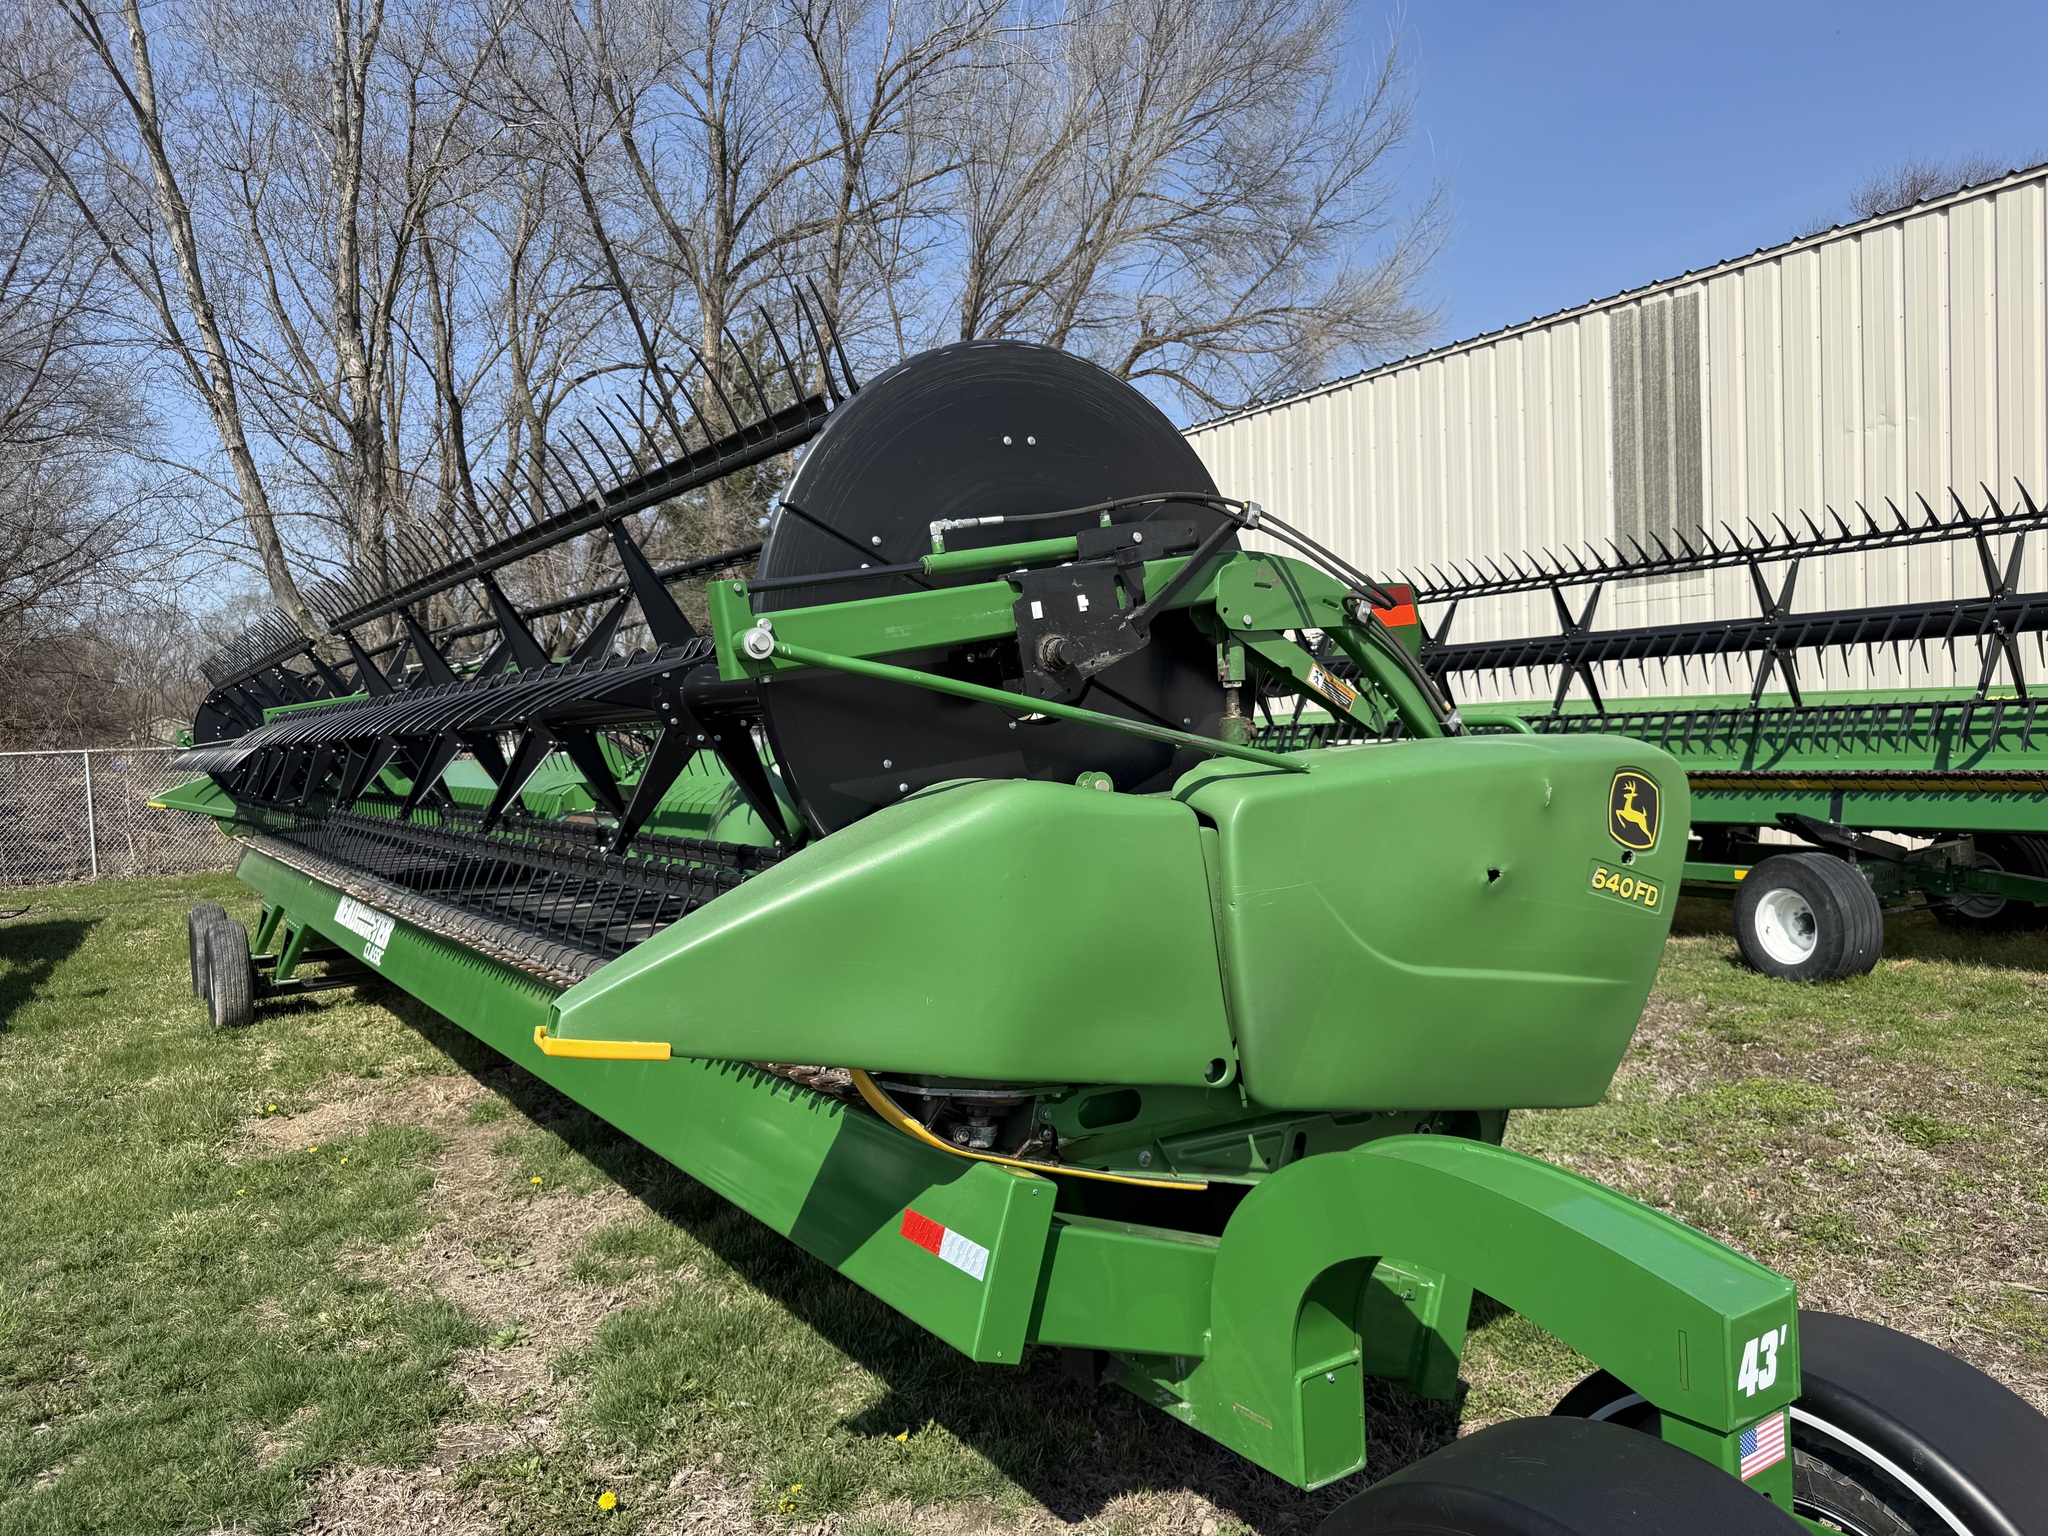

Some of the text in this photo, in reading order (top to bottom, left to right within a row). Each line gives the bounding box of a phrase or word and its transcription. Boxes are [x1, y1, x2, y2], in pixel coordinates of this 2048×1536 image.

[1591, 866, 1659, 907] 640FD
[362, 941, 385, 967] CLASSIC
[1737, 1323, 1787, 1398] 43'
